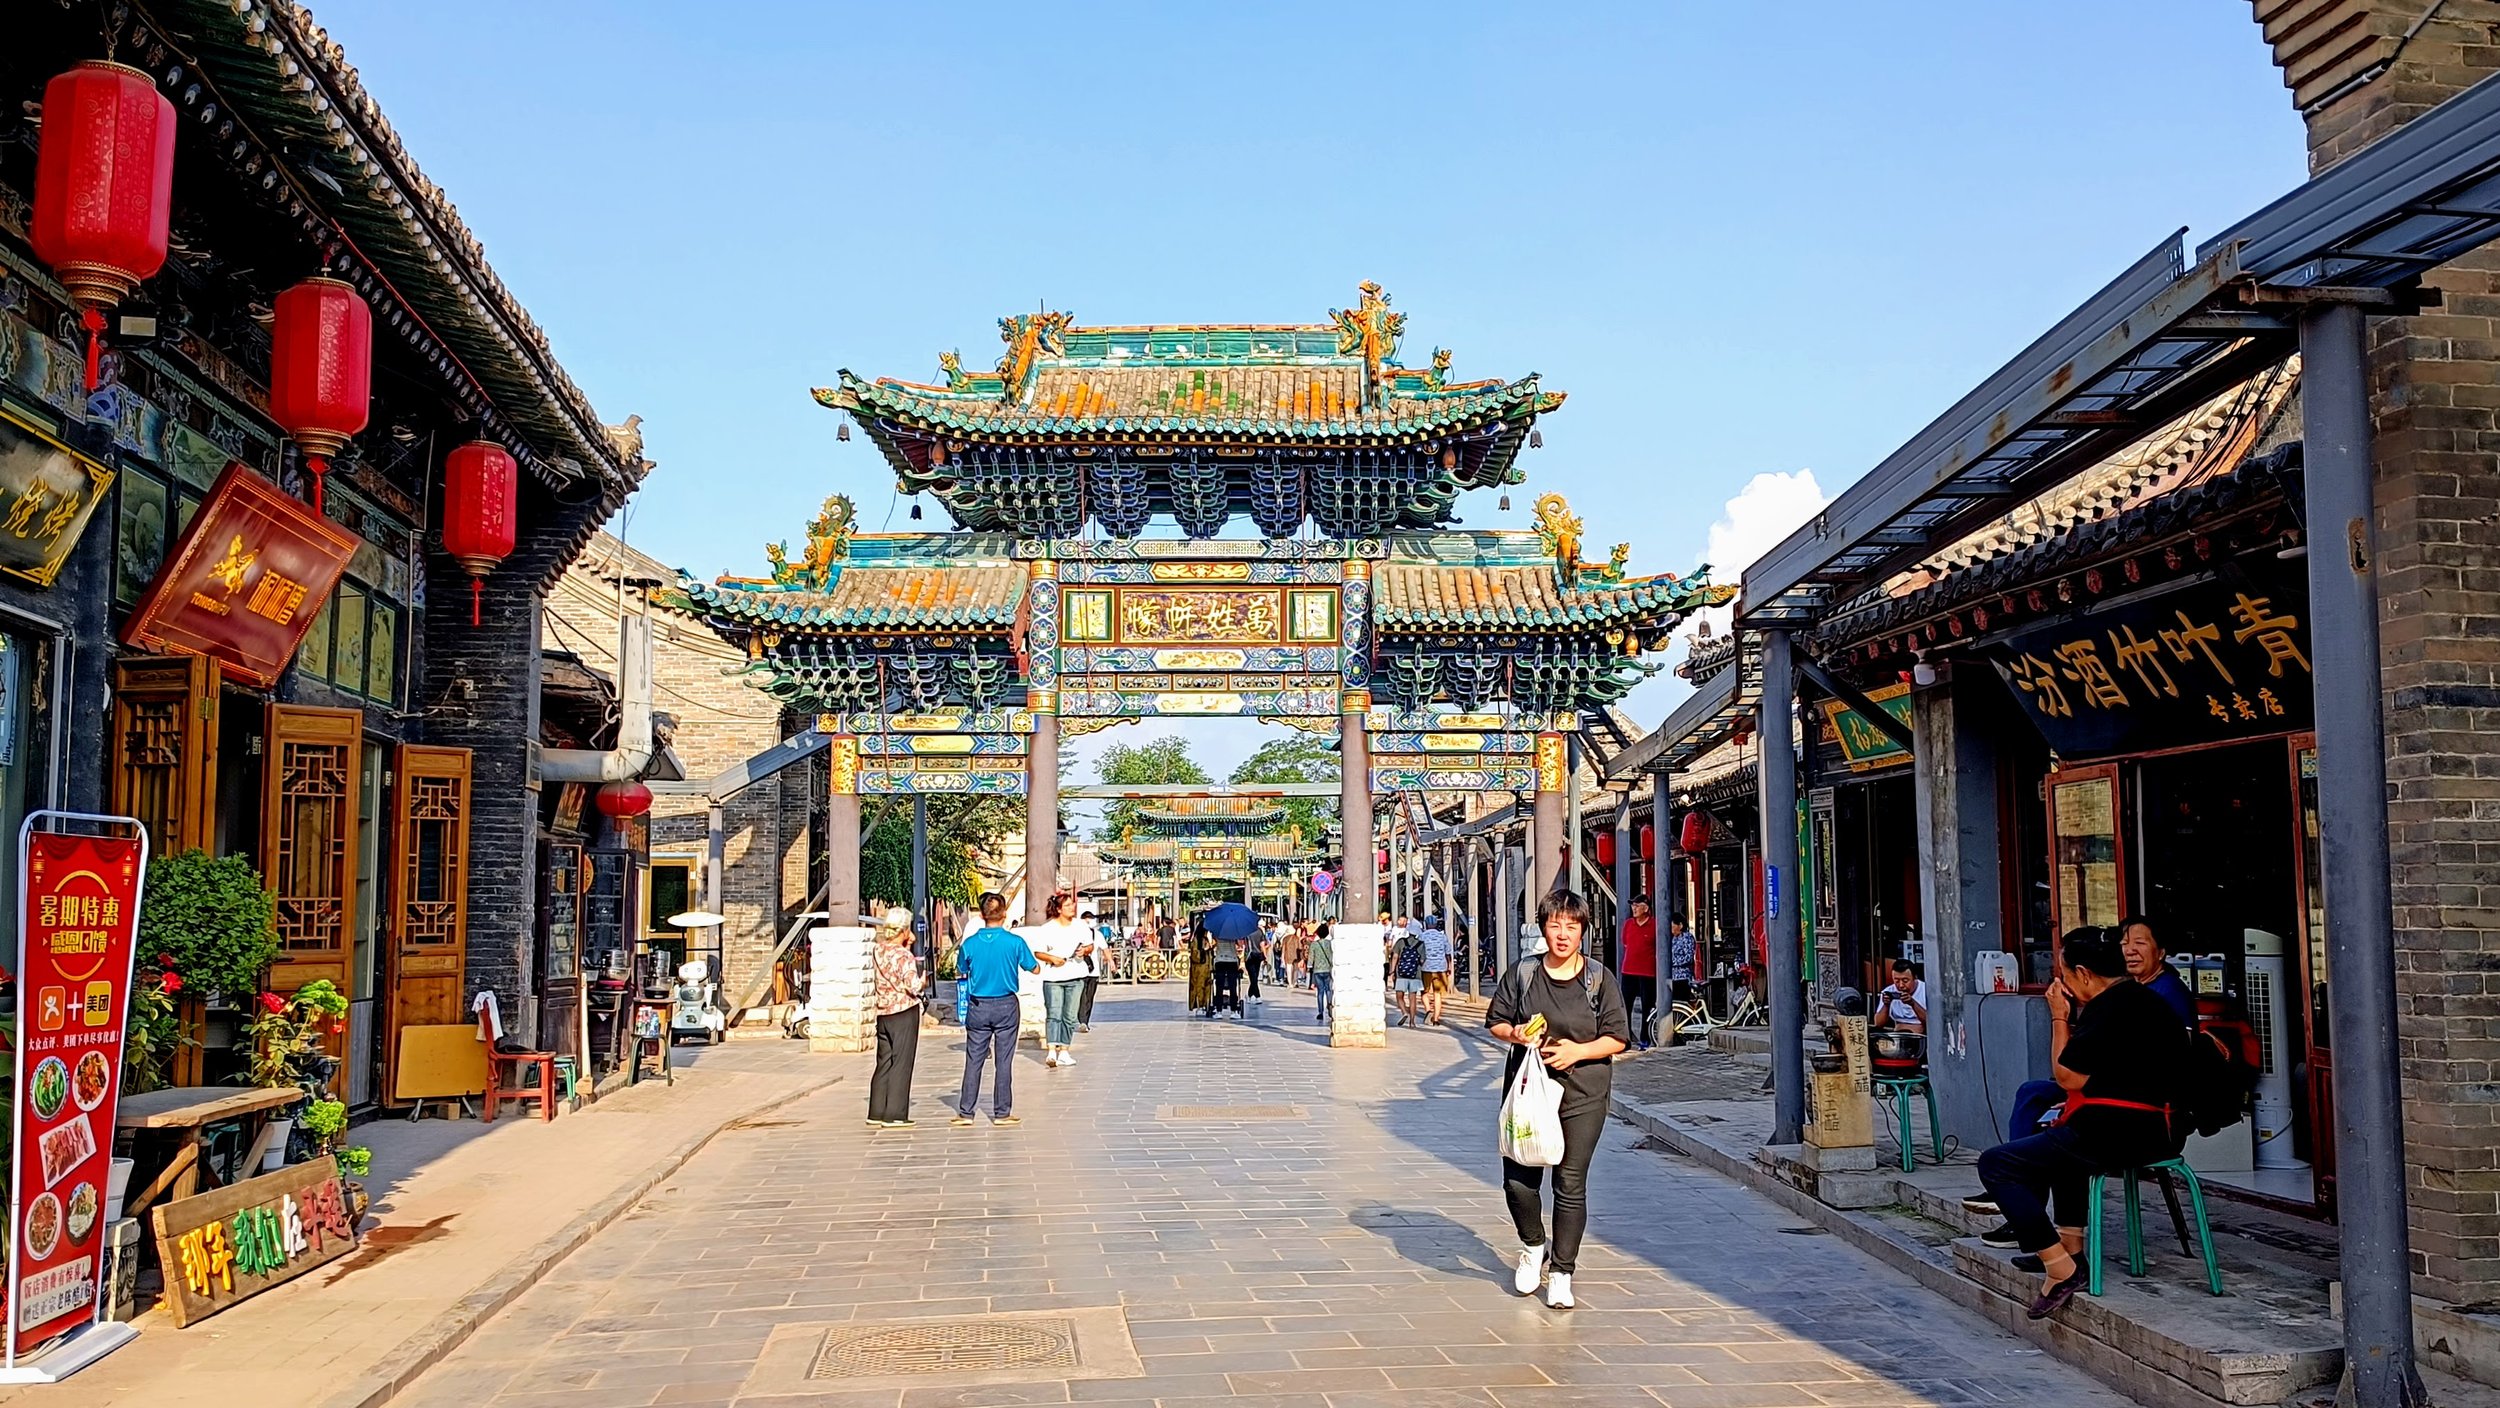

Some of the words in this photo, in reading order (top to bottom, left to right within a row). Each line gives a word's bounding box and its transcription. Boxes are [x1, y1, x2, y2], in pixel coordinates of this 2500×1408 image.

[2205, 687, 2286, 723] 专卖店
[40, 895, 120, 926] 暑期特惠
[50, 930, 108, 954] 感恩回馈
[86, 994, 109, 1012] 美团
